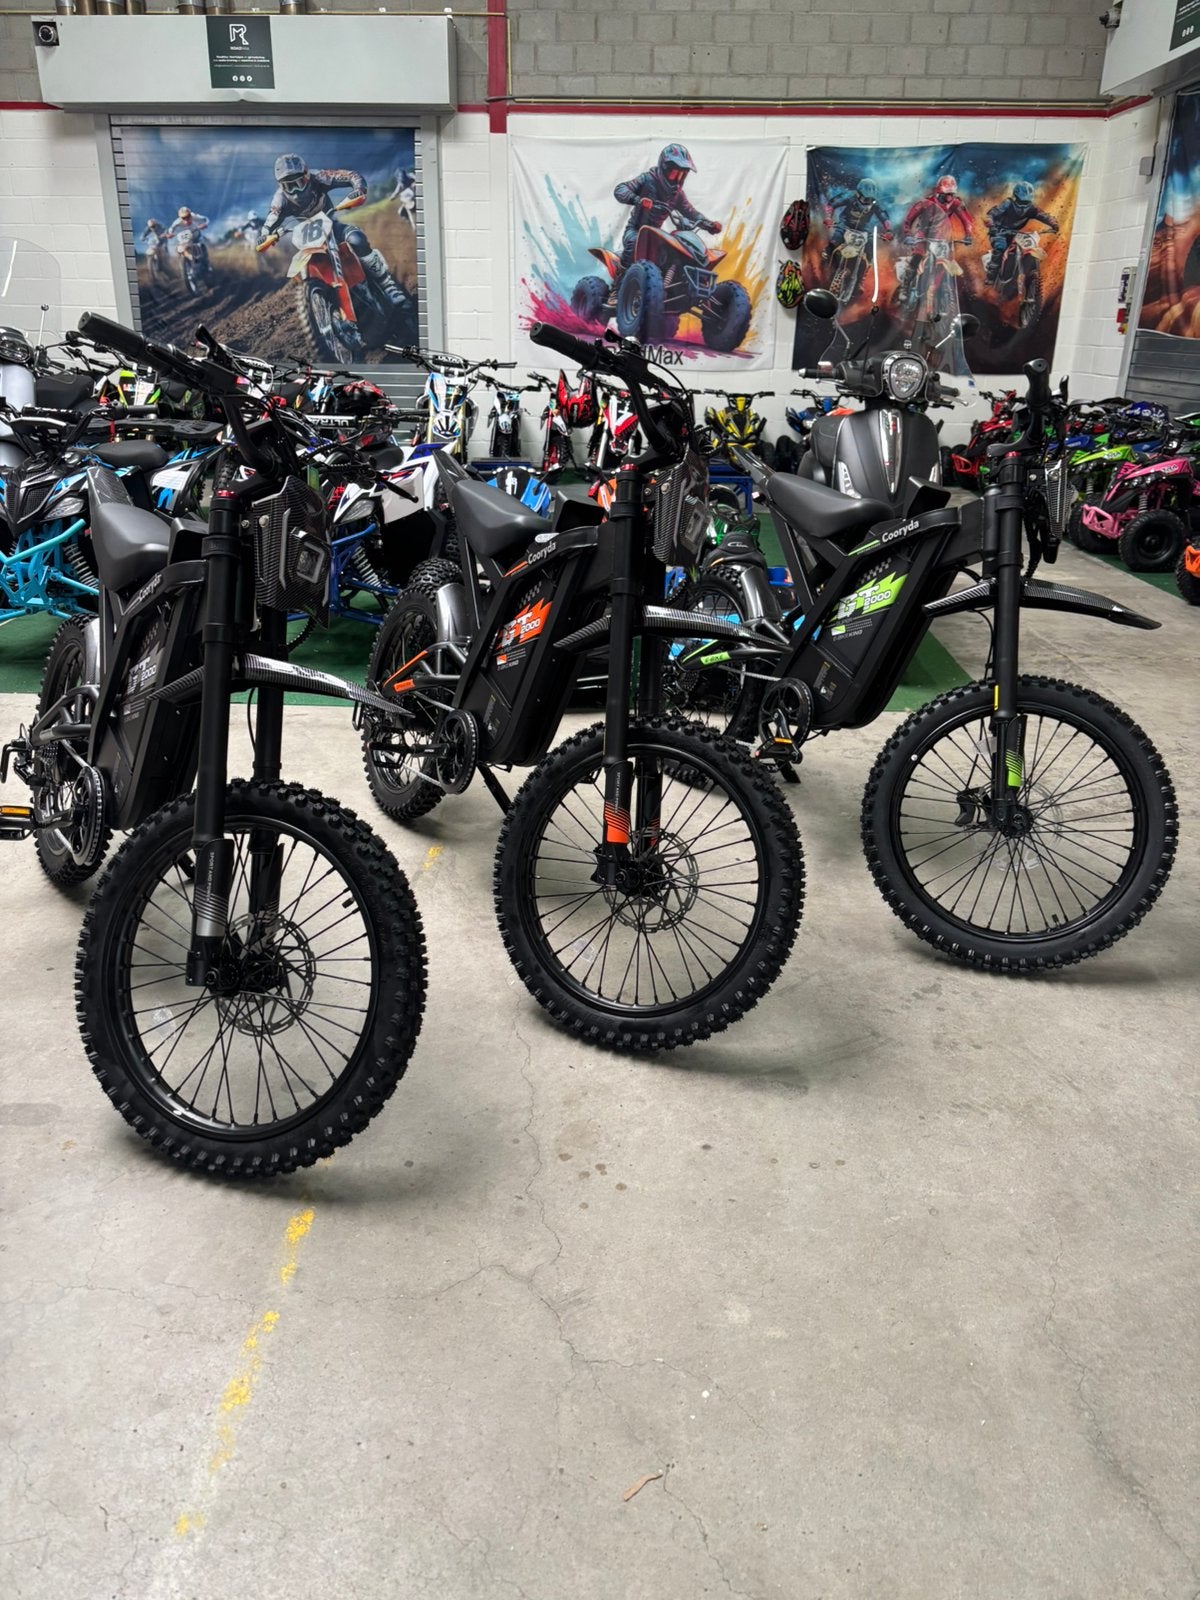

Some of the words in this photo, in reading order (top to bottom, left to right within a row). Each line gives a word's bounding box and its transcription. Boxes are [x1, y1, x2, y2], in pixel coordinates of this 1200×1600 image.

[882, 520, 919, 543] Cooryda
[528, 541, 556, 564] Cooryda
[863, 591, 891, 607] 2000
[521, 618, 540, 634] 2000
